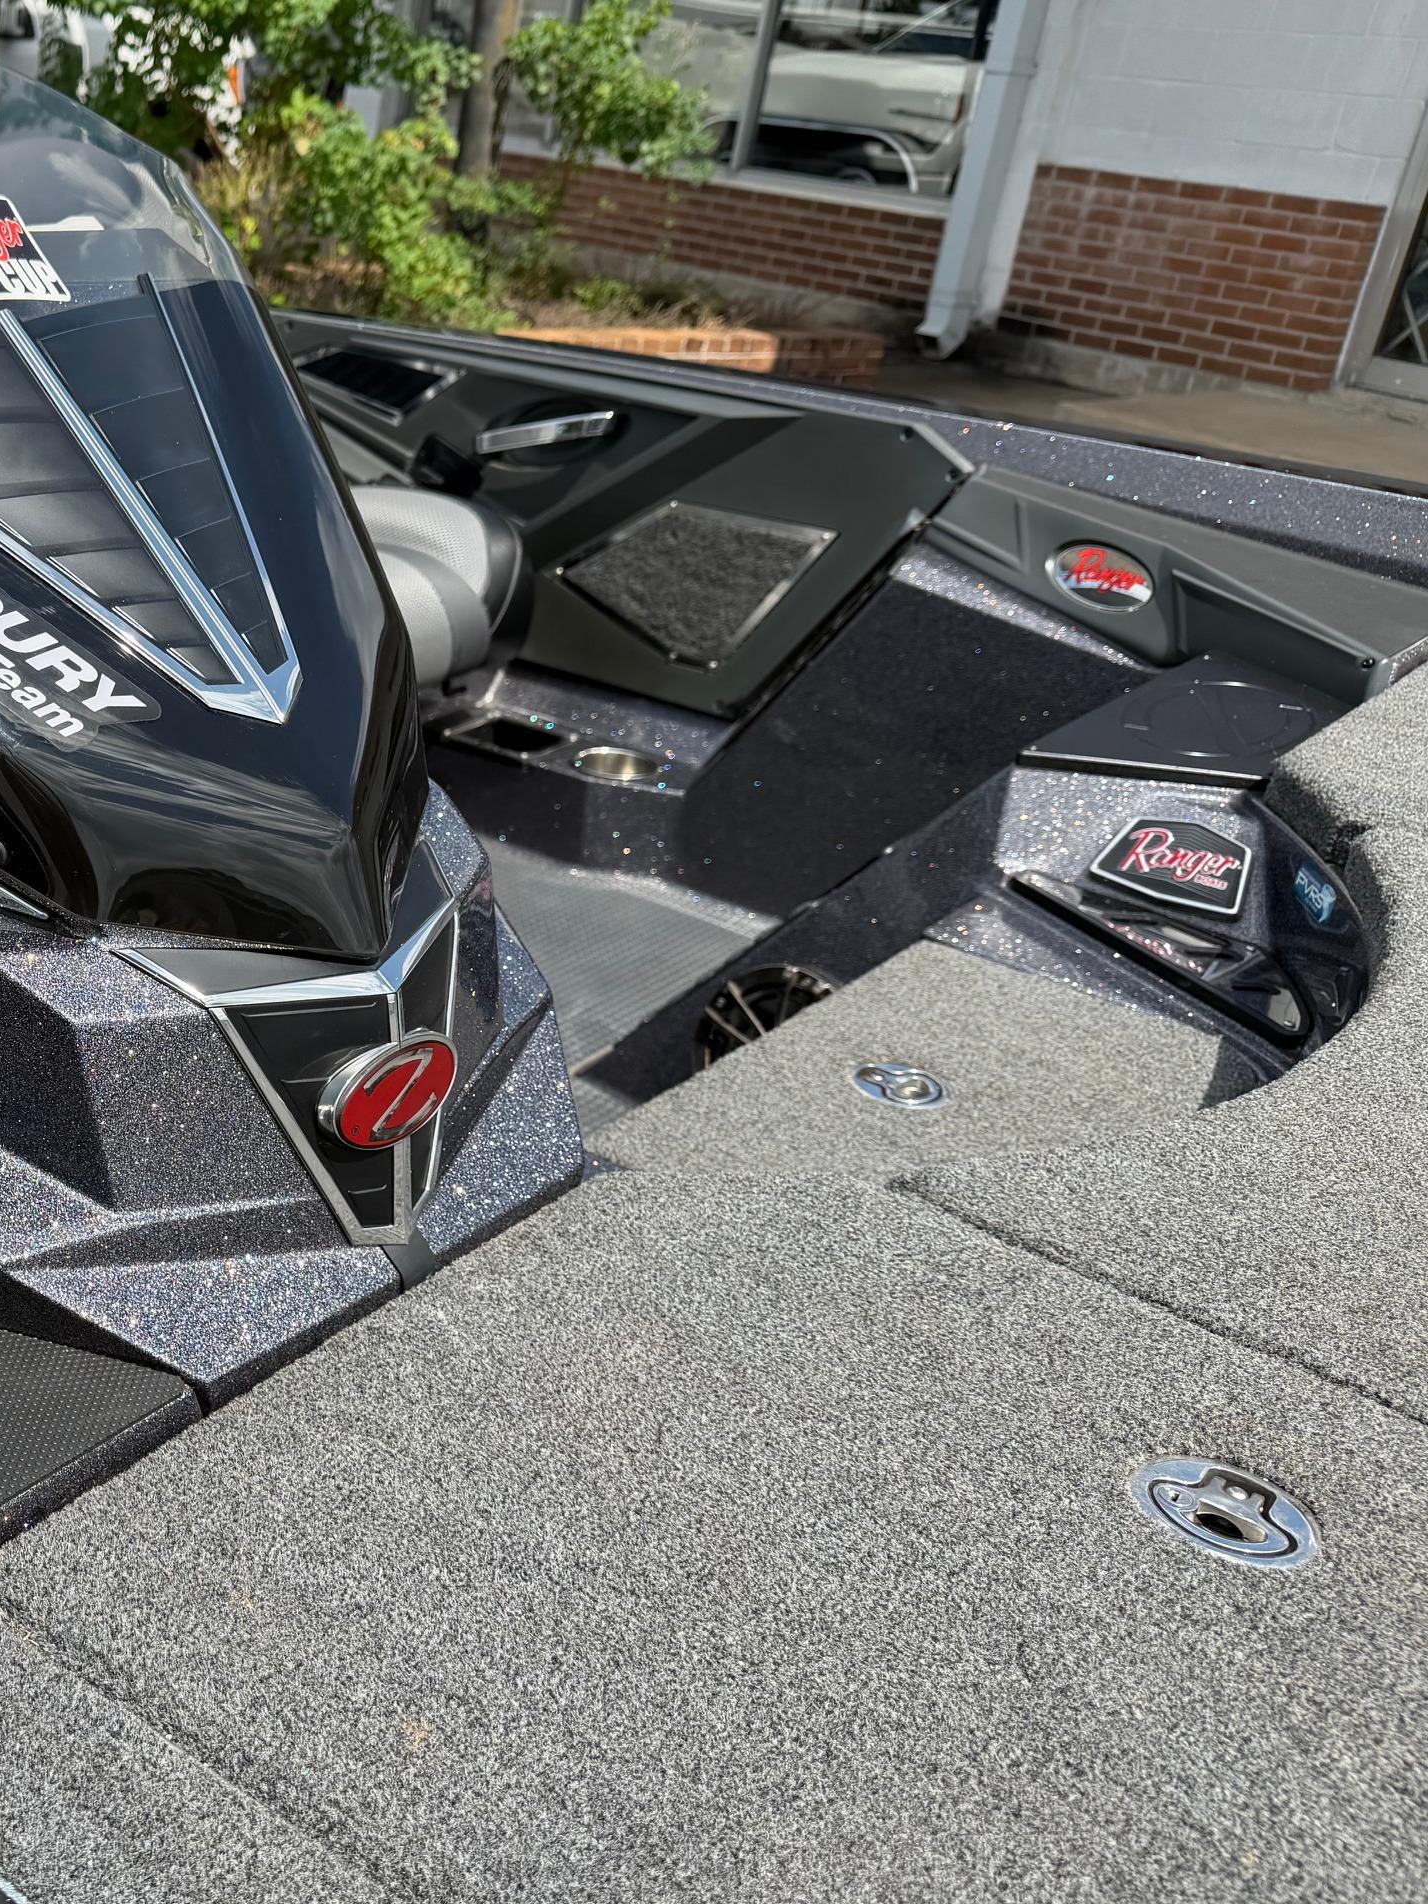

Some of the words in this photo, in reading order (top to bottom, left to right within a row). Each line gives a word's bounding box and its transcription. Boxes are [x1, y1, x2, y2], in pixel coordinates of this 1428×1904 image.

[1071, 546, 1146, 595] Ranger
[1118, 827, 1241, 883] Ranger
[1294, 870, 1325, 910] PVRS
